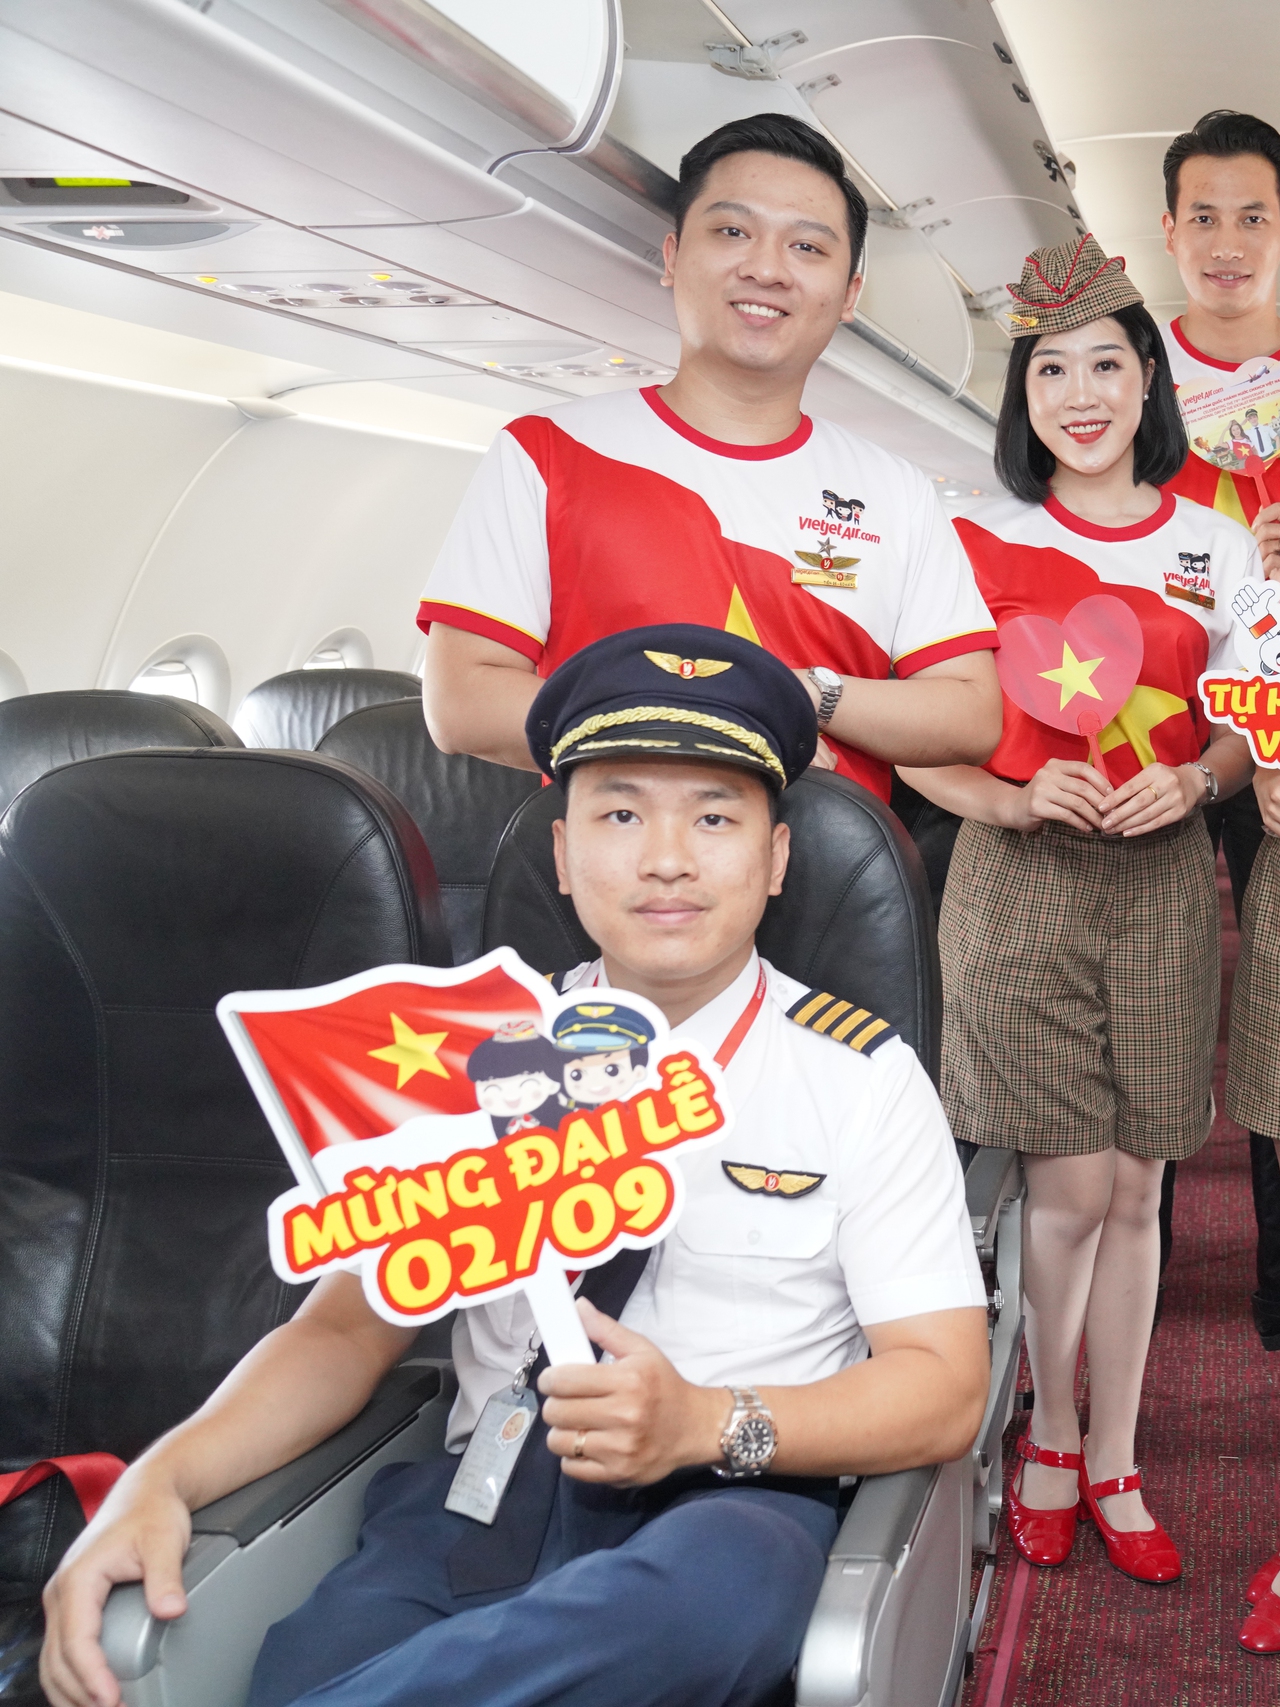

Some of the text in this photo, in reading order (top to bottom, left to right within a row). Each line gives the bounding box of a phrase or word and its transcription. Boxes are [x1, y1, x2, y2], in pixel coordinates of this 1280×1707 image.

[1208, 682, 1261, 723] TỰ
[291, 1058, 718, 1266] MỪNG ĐẠI LỄ
[385, 1165, 668, 1308] 02/09
